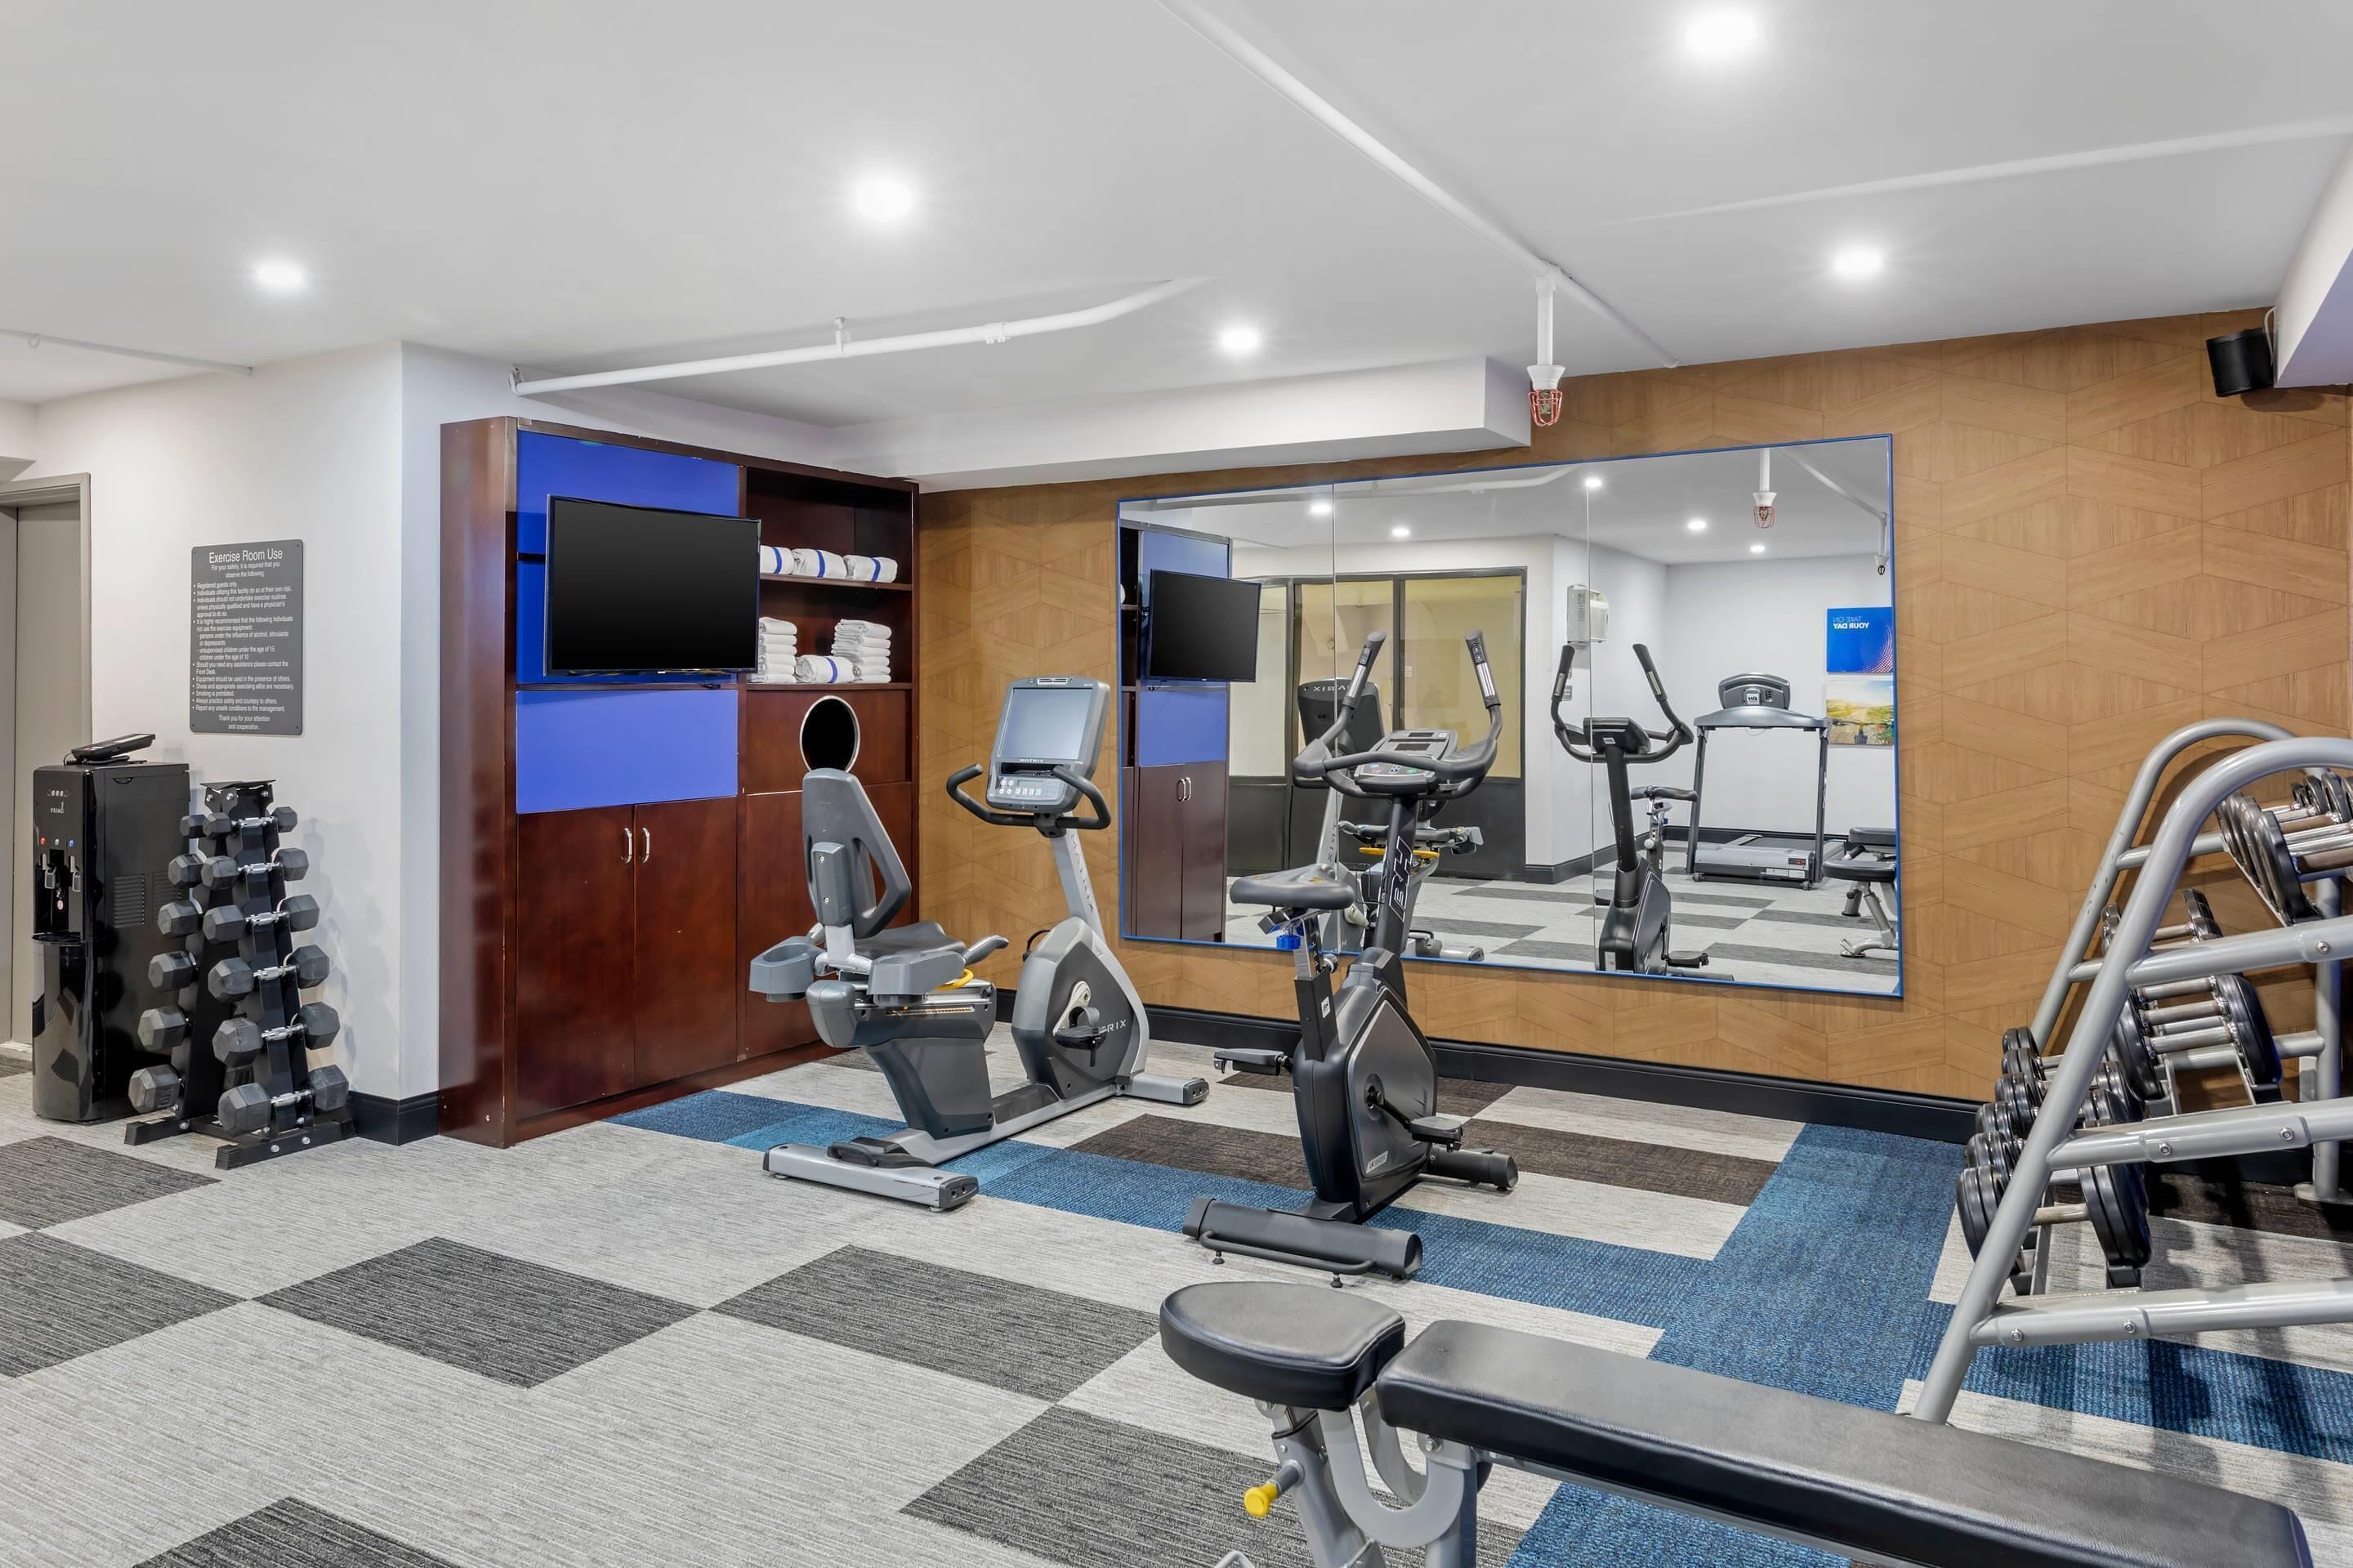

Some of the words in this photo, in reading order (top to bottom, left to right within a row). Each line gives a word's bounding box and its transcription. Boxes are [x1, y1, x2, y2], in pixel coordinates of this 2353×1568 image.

[209, 552, 240, 563] Exercise
[243, 550, 265, 561] Room
[268, 548, 283, 559] Use
[1389, 836, 1413, 922] BH
